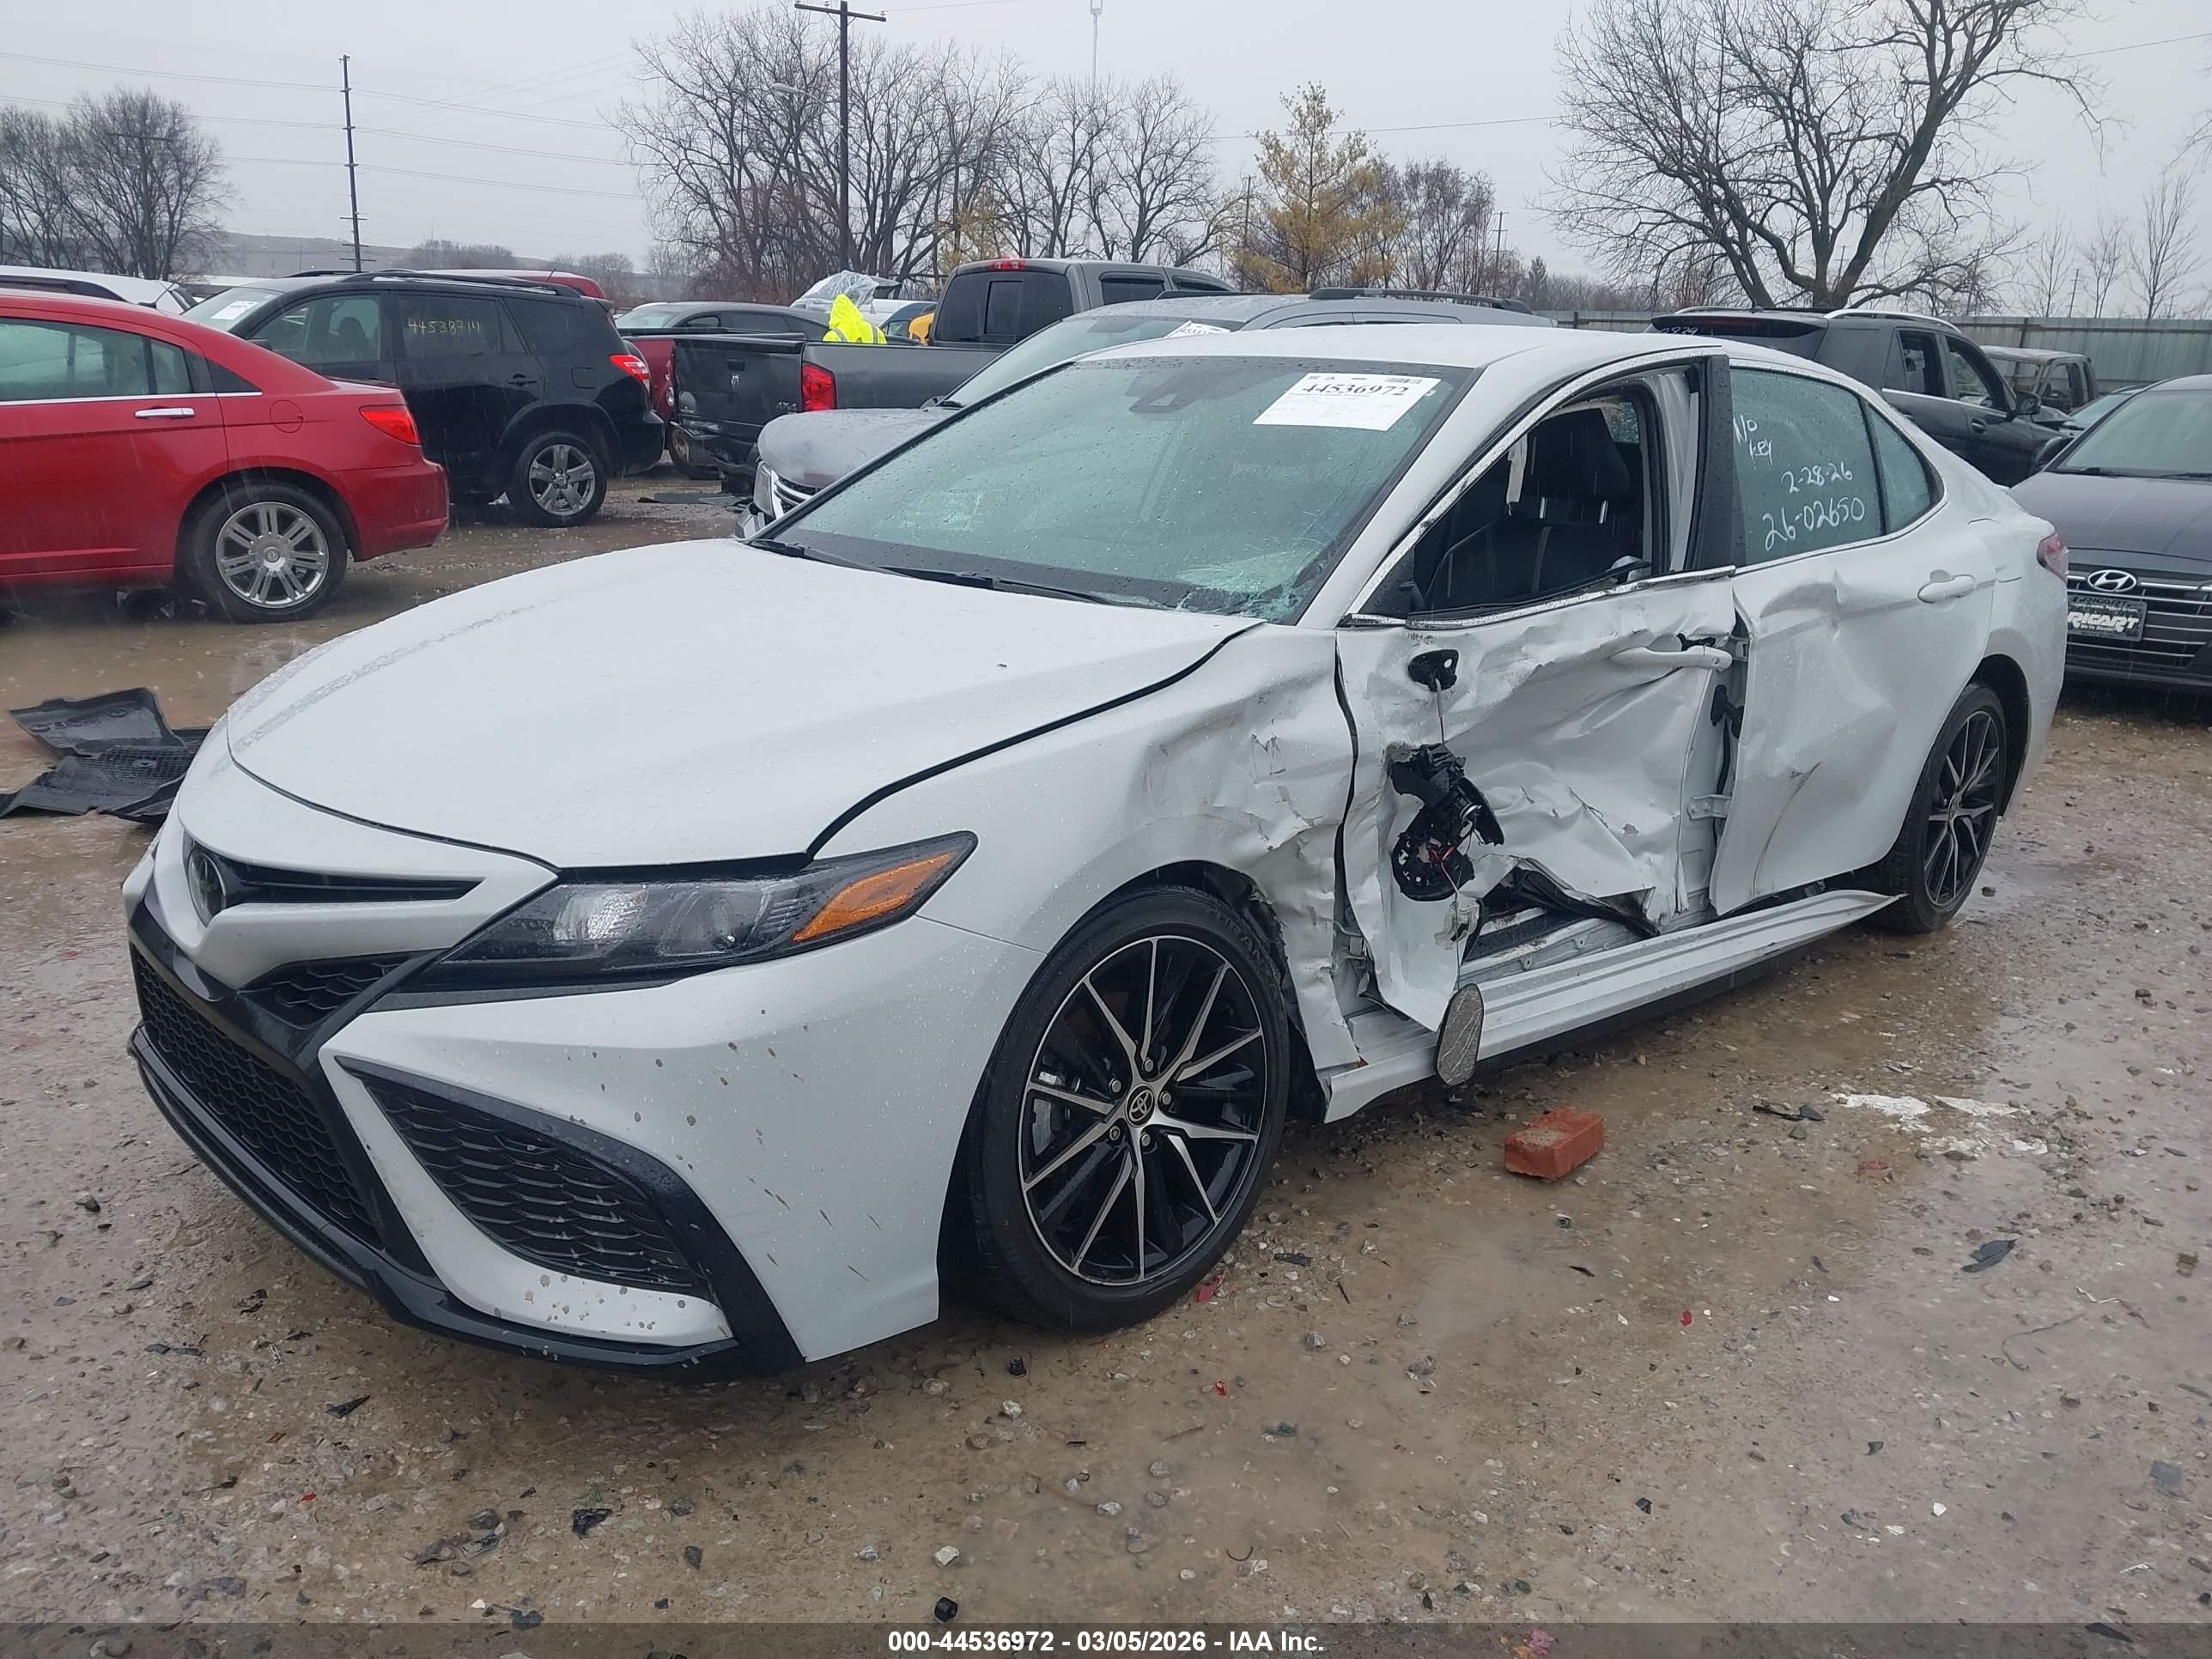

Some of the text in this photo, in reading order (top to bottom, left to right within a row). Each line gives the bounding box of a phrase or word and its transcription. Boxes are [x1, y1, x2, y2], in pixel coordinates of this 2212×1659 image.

[1303, 383, 1409, 396] 44536972
[1762, 496, 1865, 551] 26-02650
[2068, 611, 2140, 632] RICART
